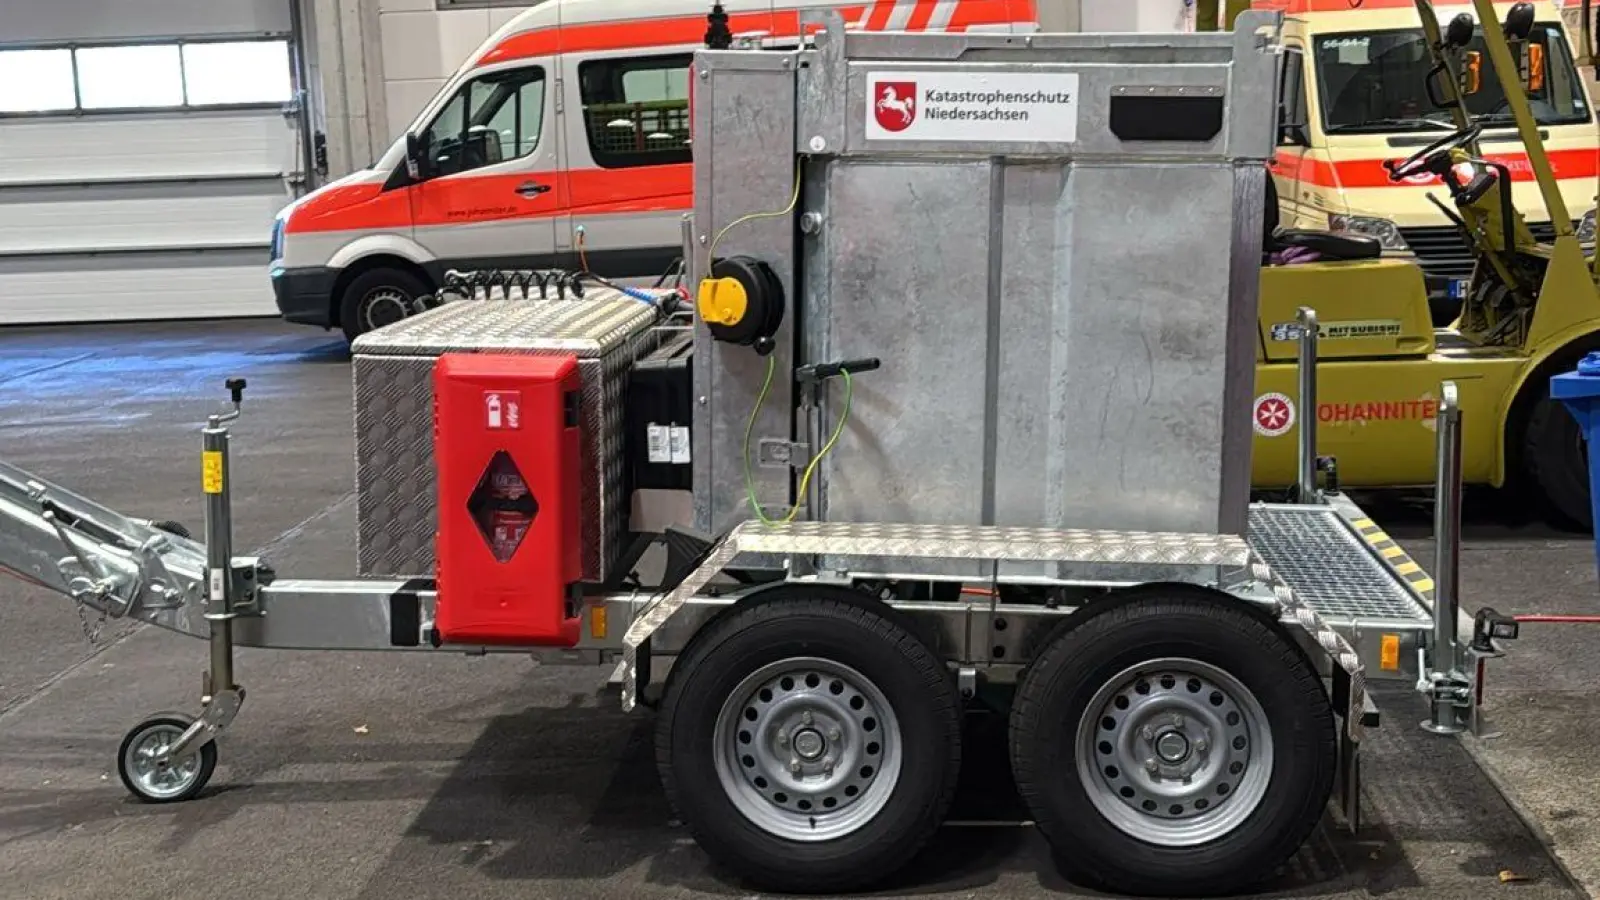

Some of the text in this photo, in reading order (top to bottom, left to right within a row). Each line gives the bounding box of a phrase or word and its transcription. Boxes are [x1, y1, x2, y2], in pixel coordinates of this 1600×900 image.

[925, 90, 1070, 106] Katastrophenschutz
[925, 108, 1030, 121] Niedersachsen
[1328, 325, 1401, 334] MITSUBISHI
[1317, 400, 1439, 423] OHANNITE
